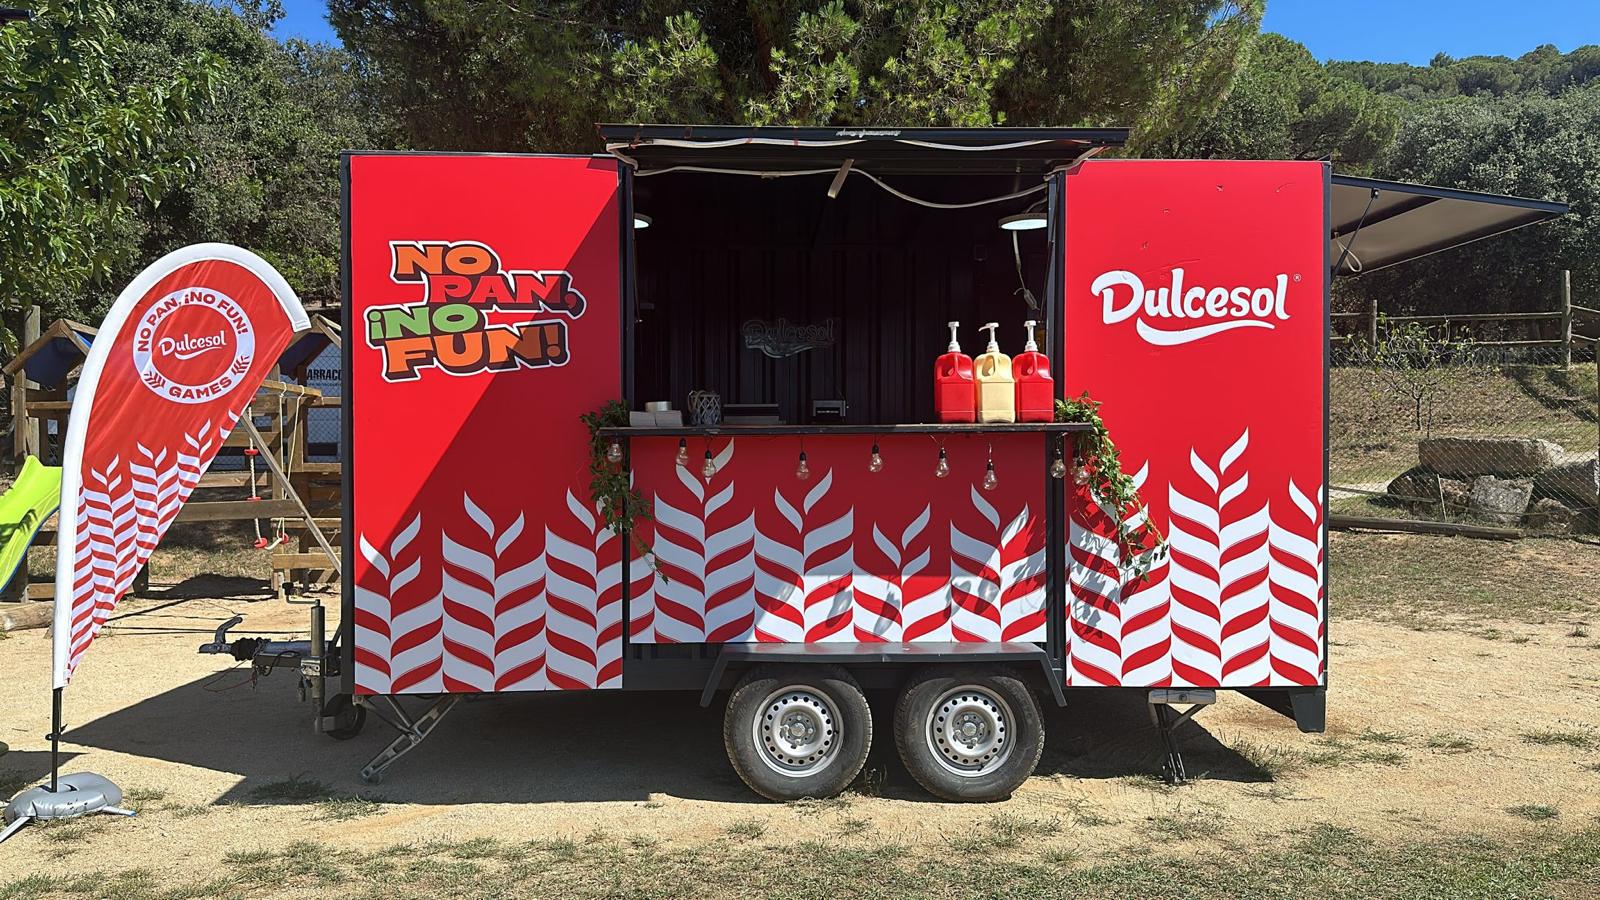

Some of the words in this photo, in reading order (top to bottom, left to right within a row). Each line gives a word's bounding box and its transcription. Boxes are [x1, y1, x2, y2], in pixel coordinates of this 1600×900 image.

[394, 244, 497, 278] NO
[427, 273, 584, 314] PAN,
[1091, 268, 1291, 326] Dulcesol
[138, 327, 152, 352] NO
[146, 297, 182, 327] PAN,
[217, 299, 249, 335] FUN!
[158, 330, 227, 357] Dulcesol
[385, 323, 564, 377] FUN!
[168, 376, 232, 399] GAMES
